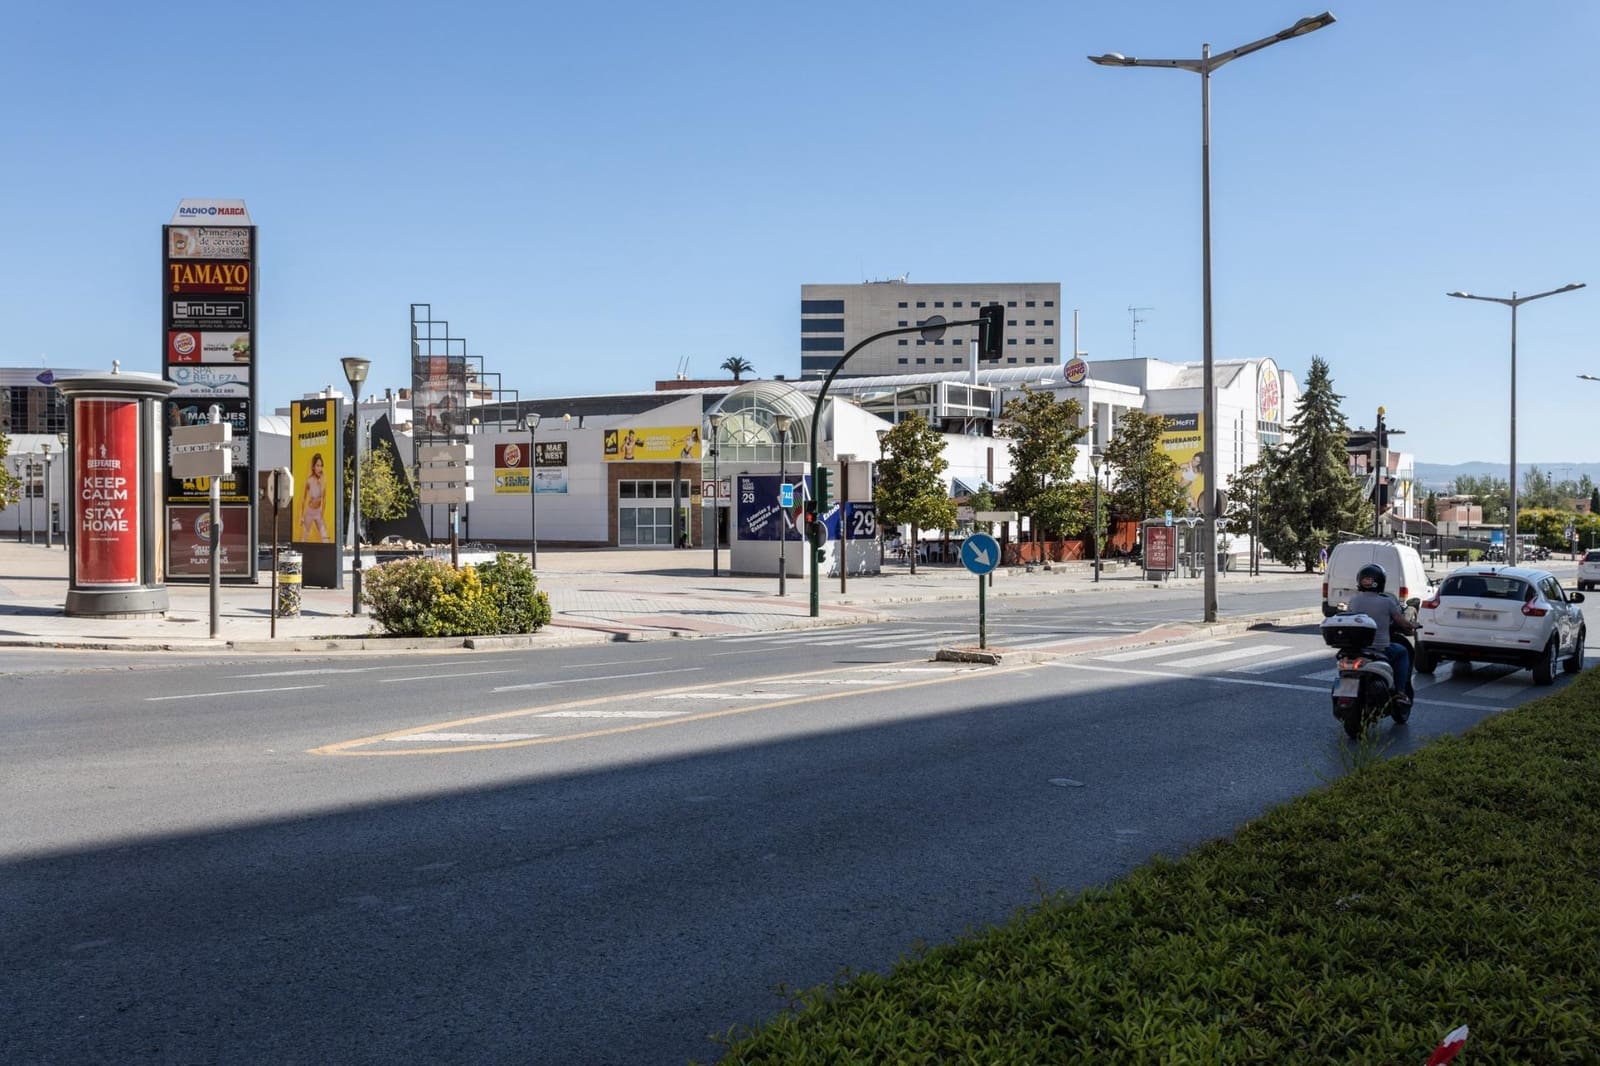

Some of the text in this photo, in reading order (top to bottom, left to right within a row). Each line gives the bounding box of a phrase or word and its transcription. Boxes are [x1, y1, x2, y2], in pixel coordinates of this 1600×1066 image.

[179, 207, 245, 216] RADIO MARCA
[171, 263, 248, 285] TAMAYO
[546, 443, 562, 451] MAE
[545, 452, 564, 460] WEST
[87, 459, 121, 469] BEEFEATER
[84, 477, 126, 488] KEEP
[82, 489, 128, 500] CALM
[742, 493, 755, 503] 29
[85, 508, 125, 519] STAY
[83, 520, 129, 531] HOME
[854, 510, 875, 535] 29
